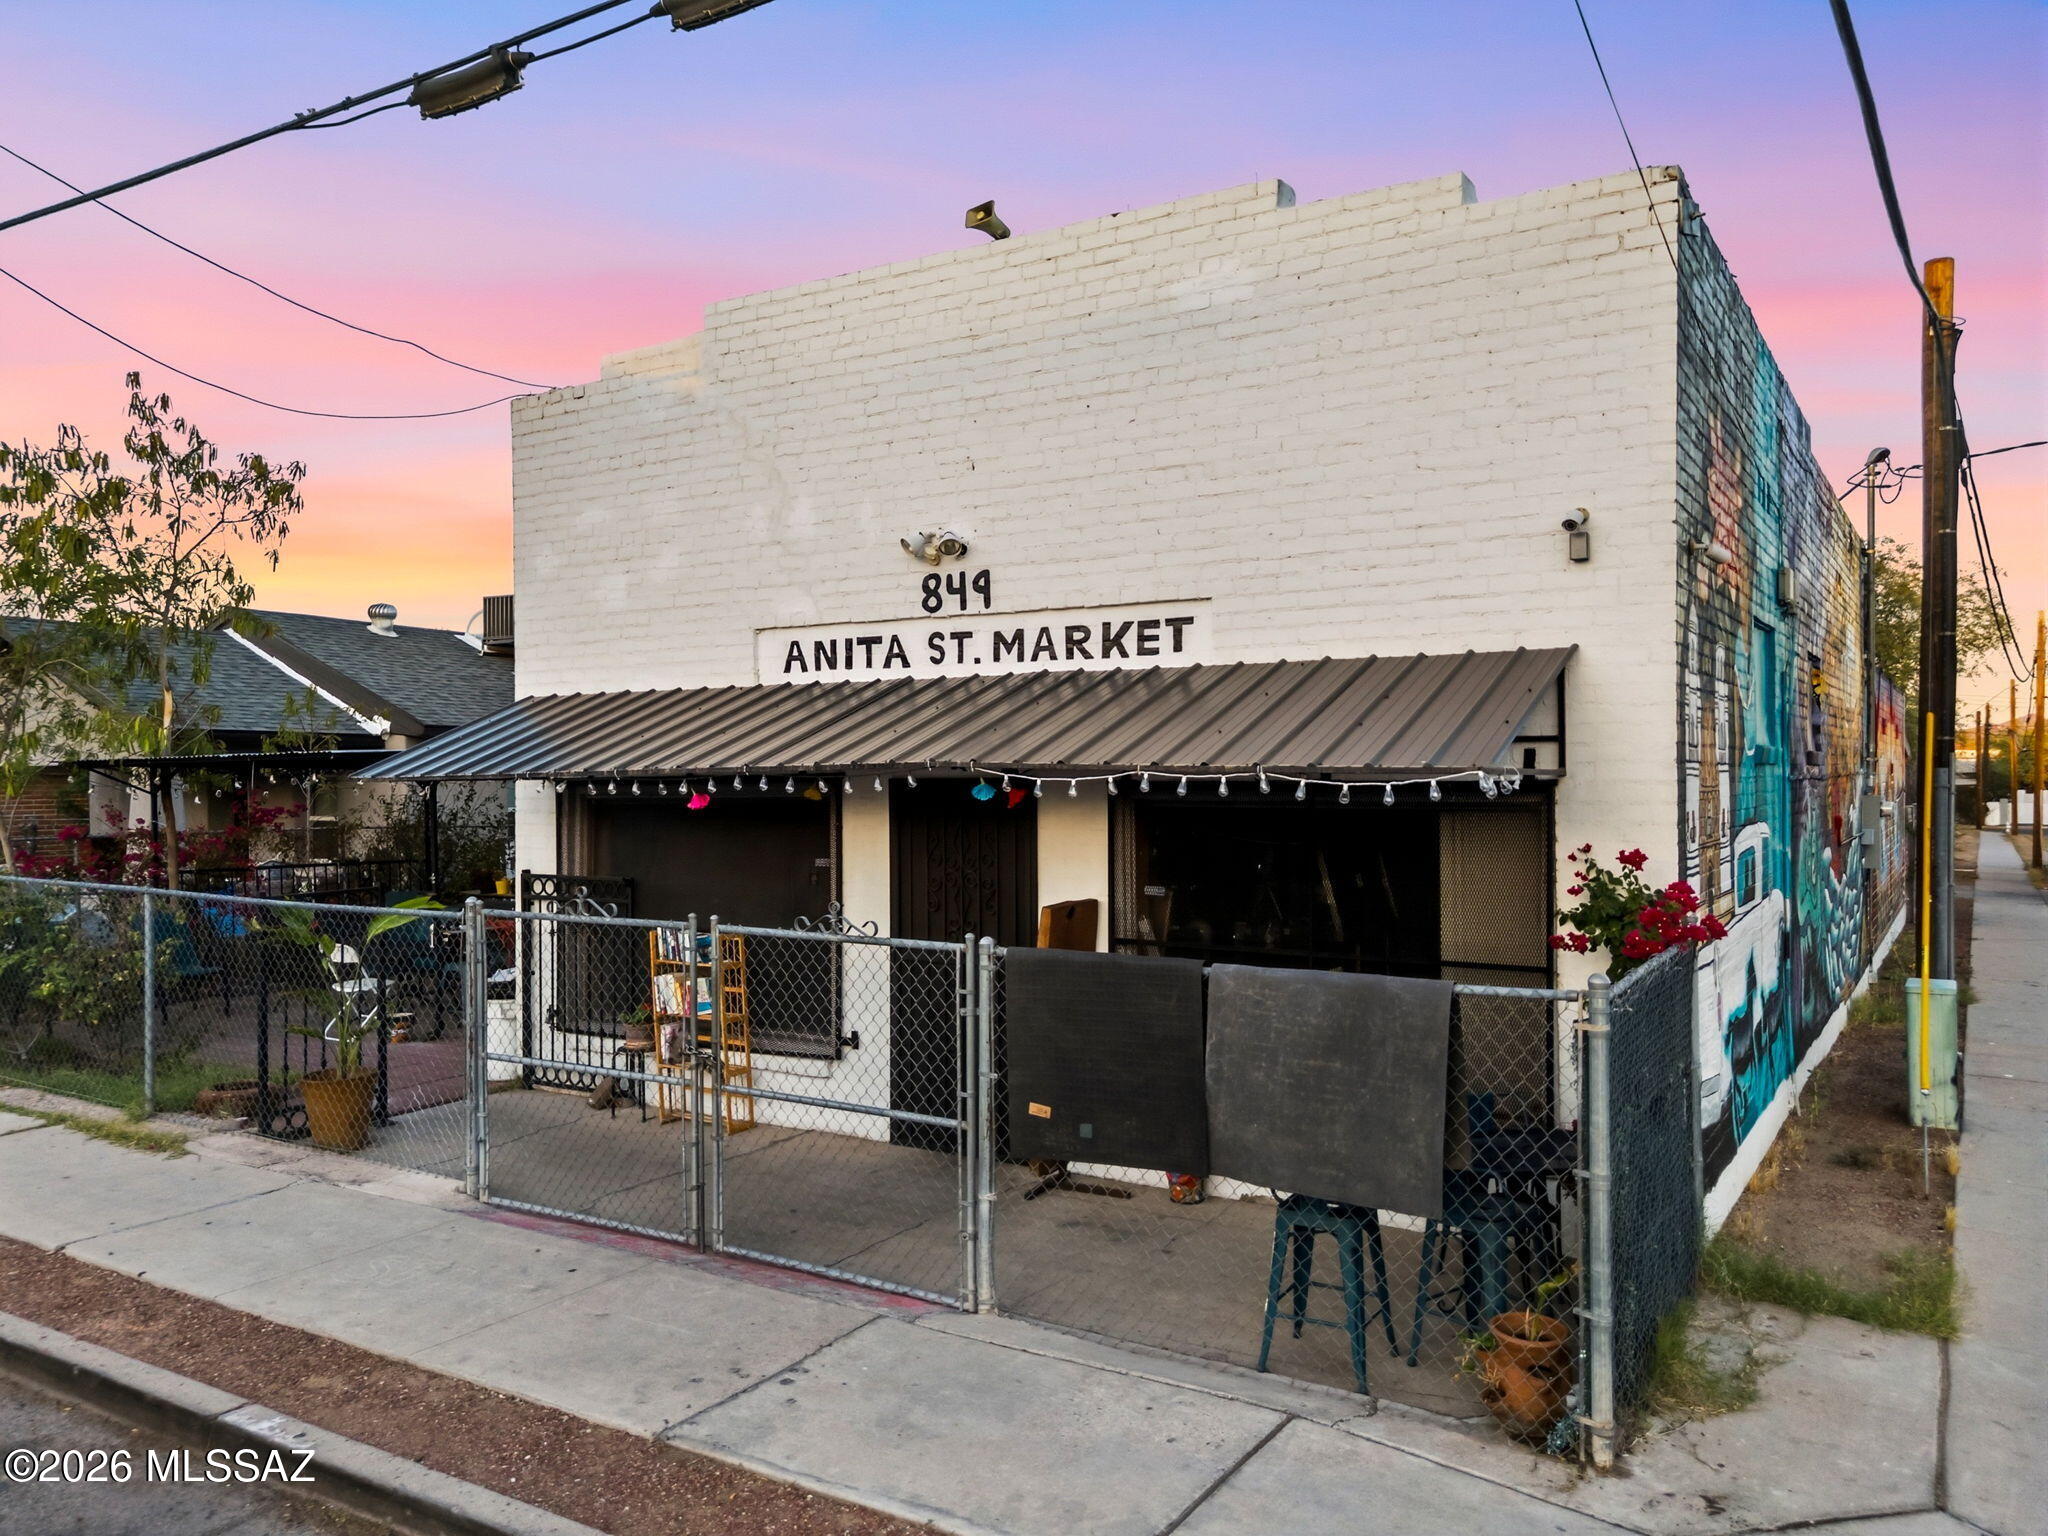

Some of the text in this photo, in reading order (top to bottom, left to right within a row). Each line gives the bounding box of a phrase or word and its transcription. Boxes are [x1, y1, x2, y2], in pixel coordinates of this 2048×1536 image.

[921, 569, 991, 614] 849
[783, 616, 1195, 674] ANITA ST. MARKET
